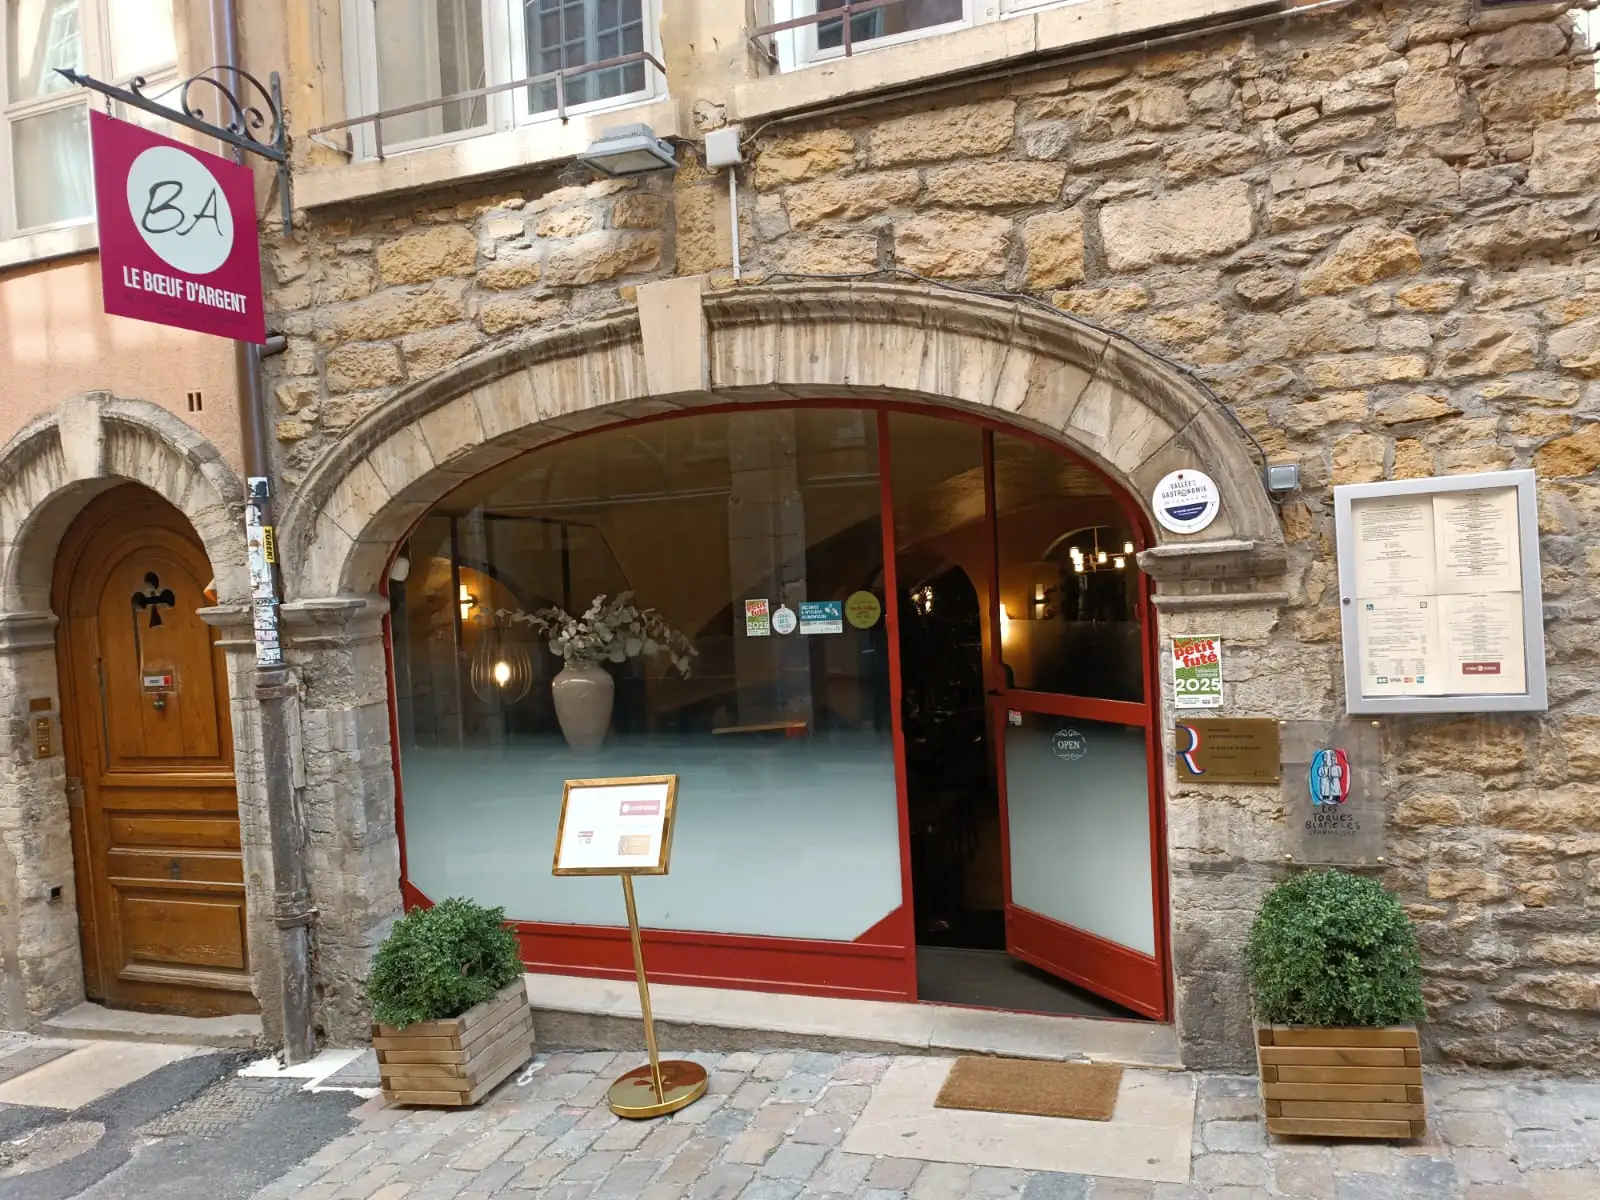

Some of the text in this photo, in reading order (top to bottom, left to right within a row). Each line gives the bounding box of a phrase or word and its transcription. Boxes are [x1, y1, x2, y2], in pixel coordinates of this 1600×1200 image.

[142, 180, 223, 237] BA
[123, 265, 142, 290] LE
[143, 270, 184, 300] BŒUF
[186, 282, 247, 314] D'ARGENT
[1161, 485, 1208, 499] GASTRONOMIE
[1173, 639, 1215, 661] petit
[1182, 651, 1218, 668] futé
[1175, 678, 1220, 692] 2025
[1057, 740, 1080, 750] OPEN
